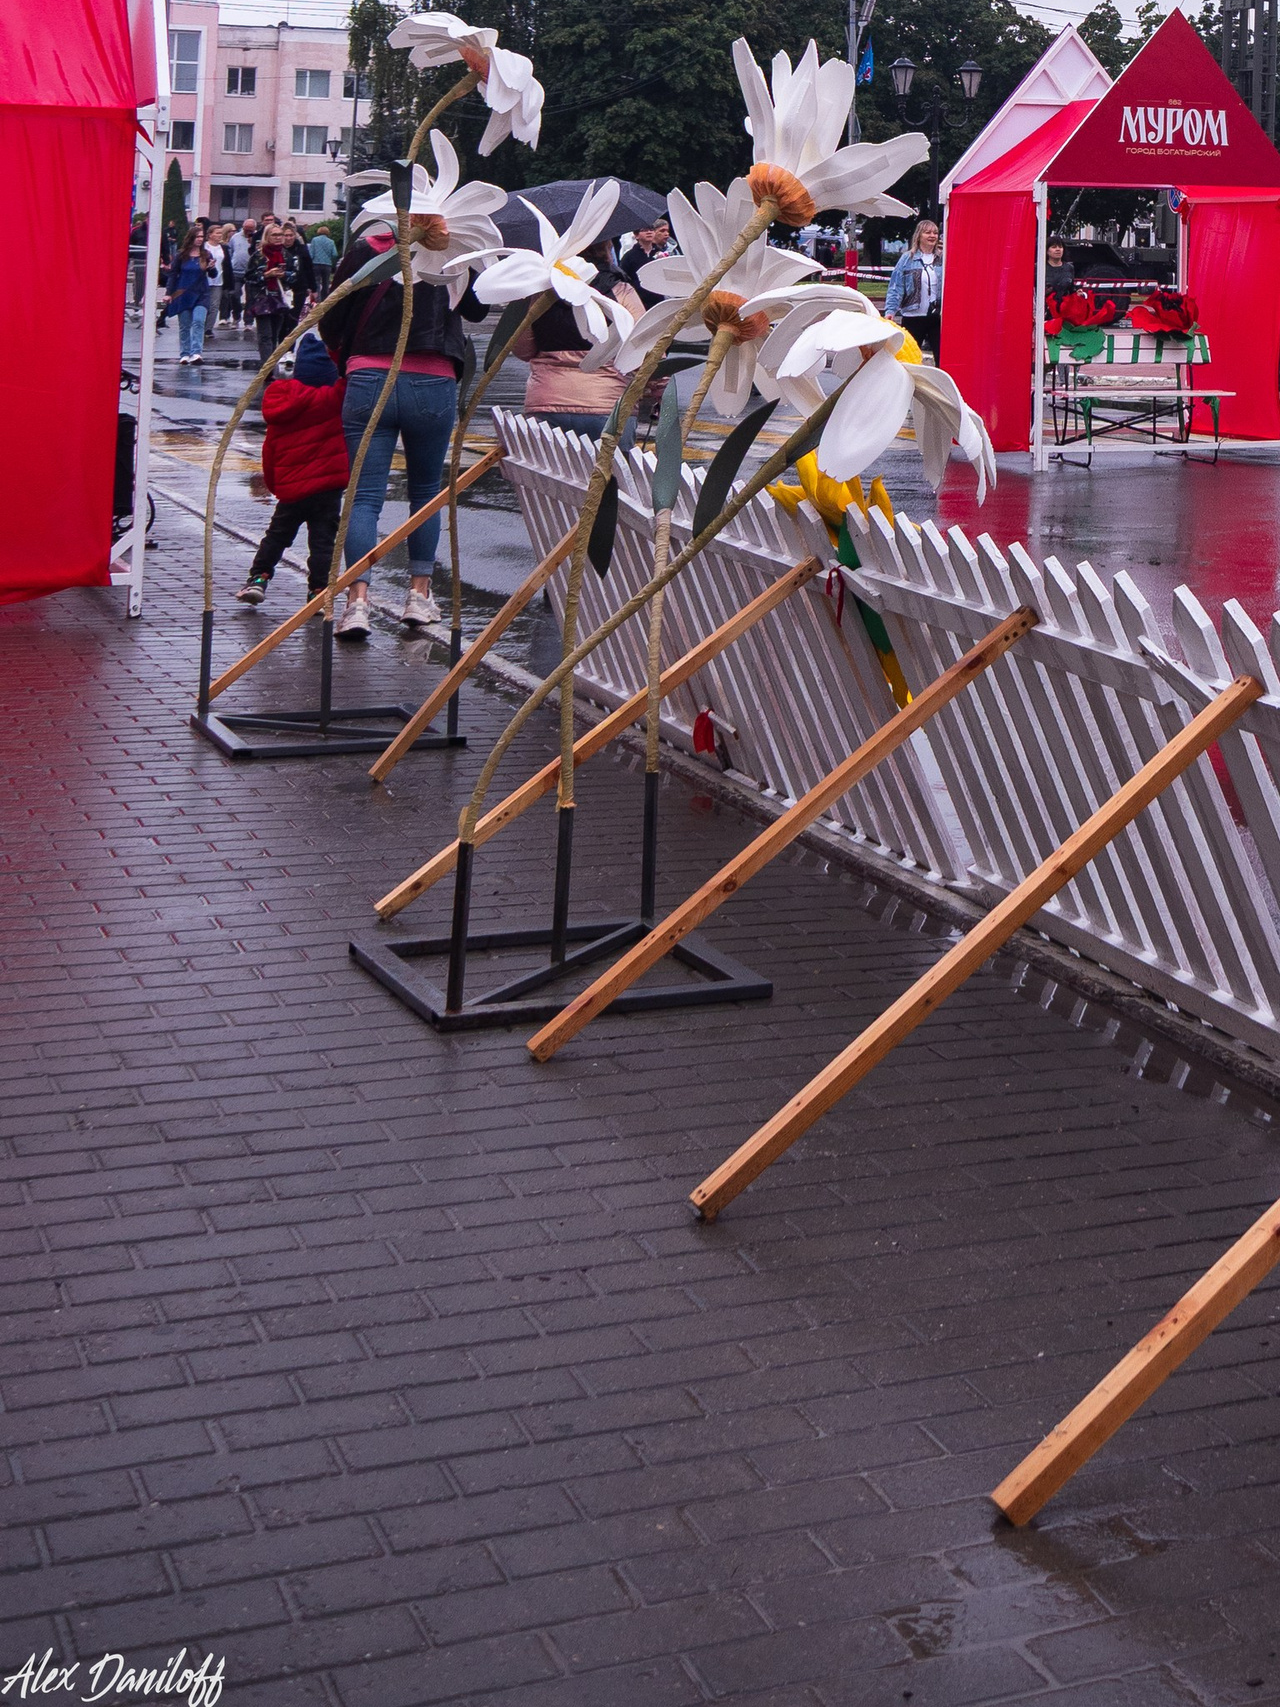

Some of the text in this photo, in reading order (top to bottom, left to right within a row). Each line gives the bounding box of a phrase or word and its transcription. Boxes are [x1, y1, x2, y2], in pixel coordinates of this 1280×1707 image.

[1118, 106, 1229, 146] МУРОМ
[1126, 147, 1222, 157] ГОРОД БОГАТЫРСКИЙ
